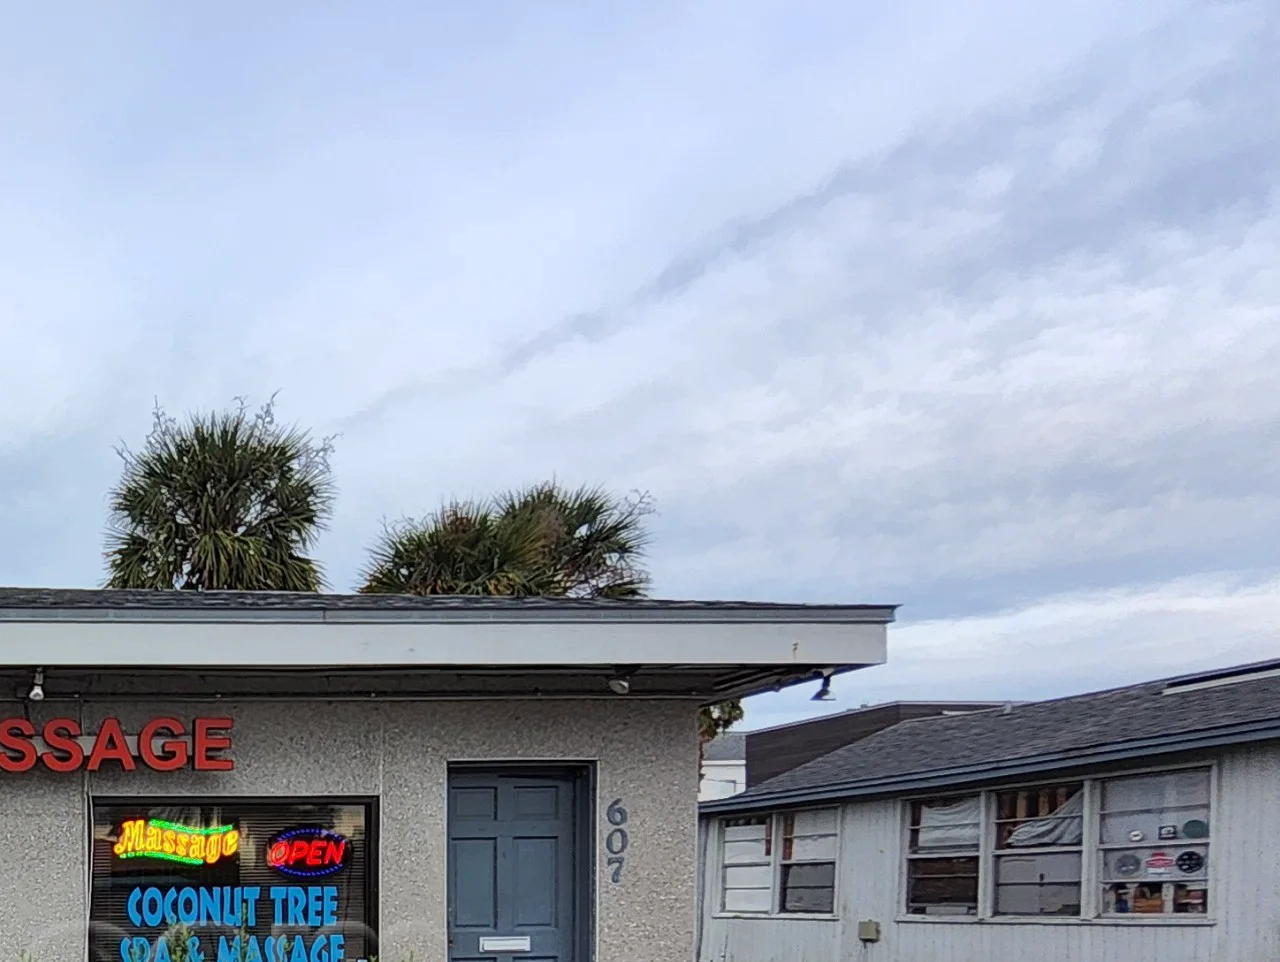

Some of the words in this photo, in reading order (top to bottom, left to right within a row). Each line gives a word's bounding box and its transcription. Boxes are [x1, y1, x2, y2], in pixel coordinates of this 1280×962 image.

[113, 818, 240, 865] Massage
[269, 839, 346, 867] OPEN
[605, 797, 629, 884] 607
[127, 886, 260, 927] COCONUT
[270, 886, 338, 927] TREE
